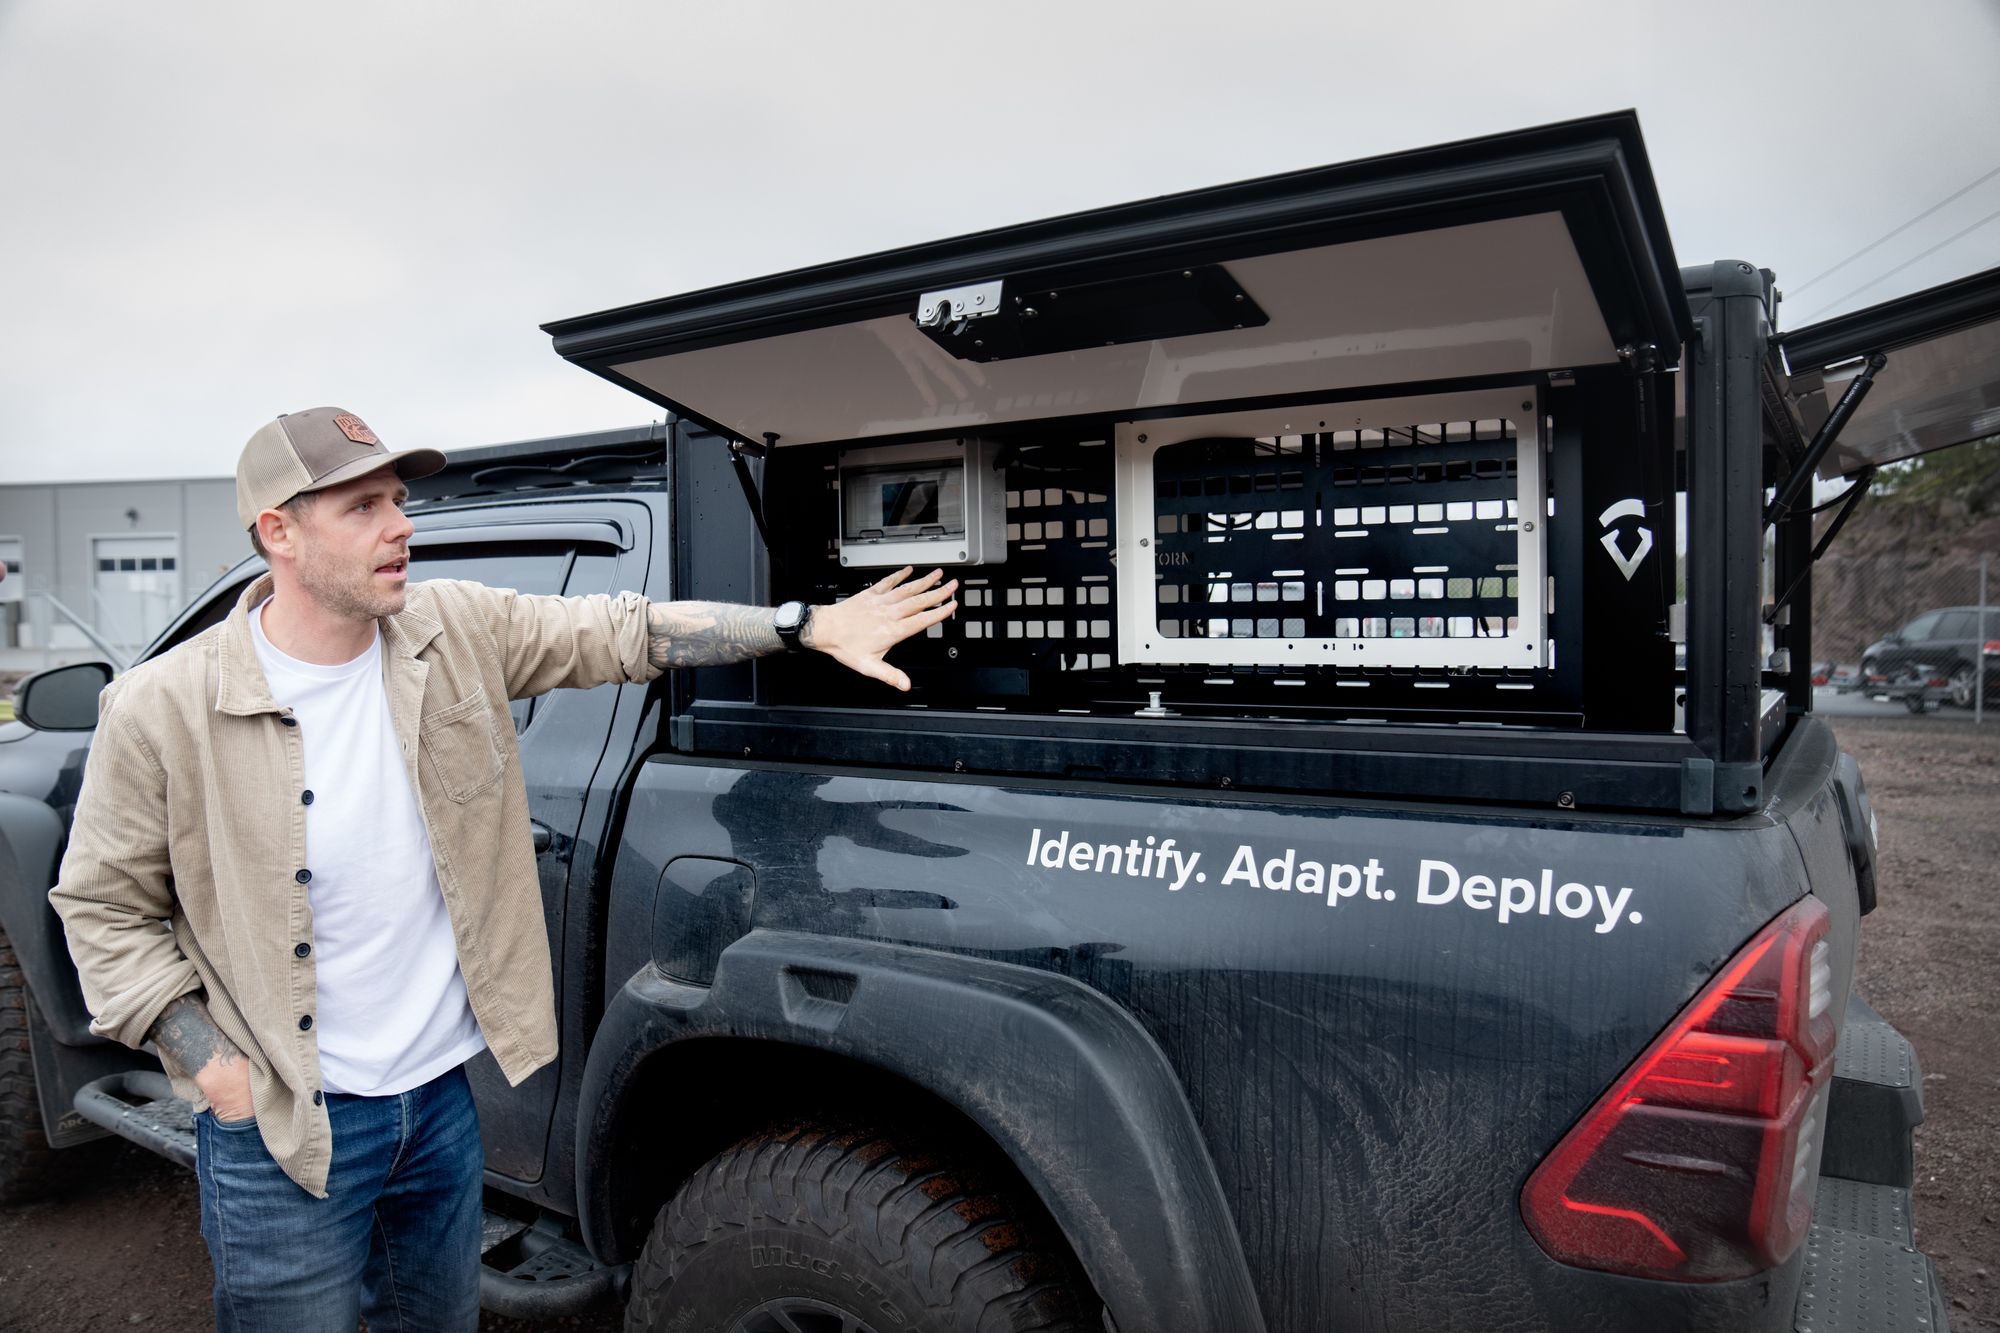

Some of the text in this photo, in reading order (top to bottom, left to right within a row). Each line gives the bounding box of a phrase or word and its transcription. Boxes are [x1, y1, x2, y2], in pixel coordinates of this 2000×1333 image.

[1026, 828, 1643, 934] Identify. Adapt. Deploy.
